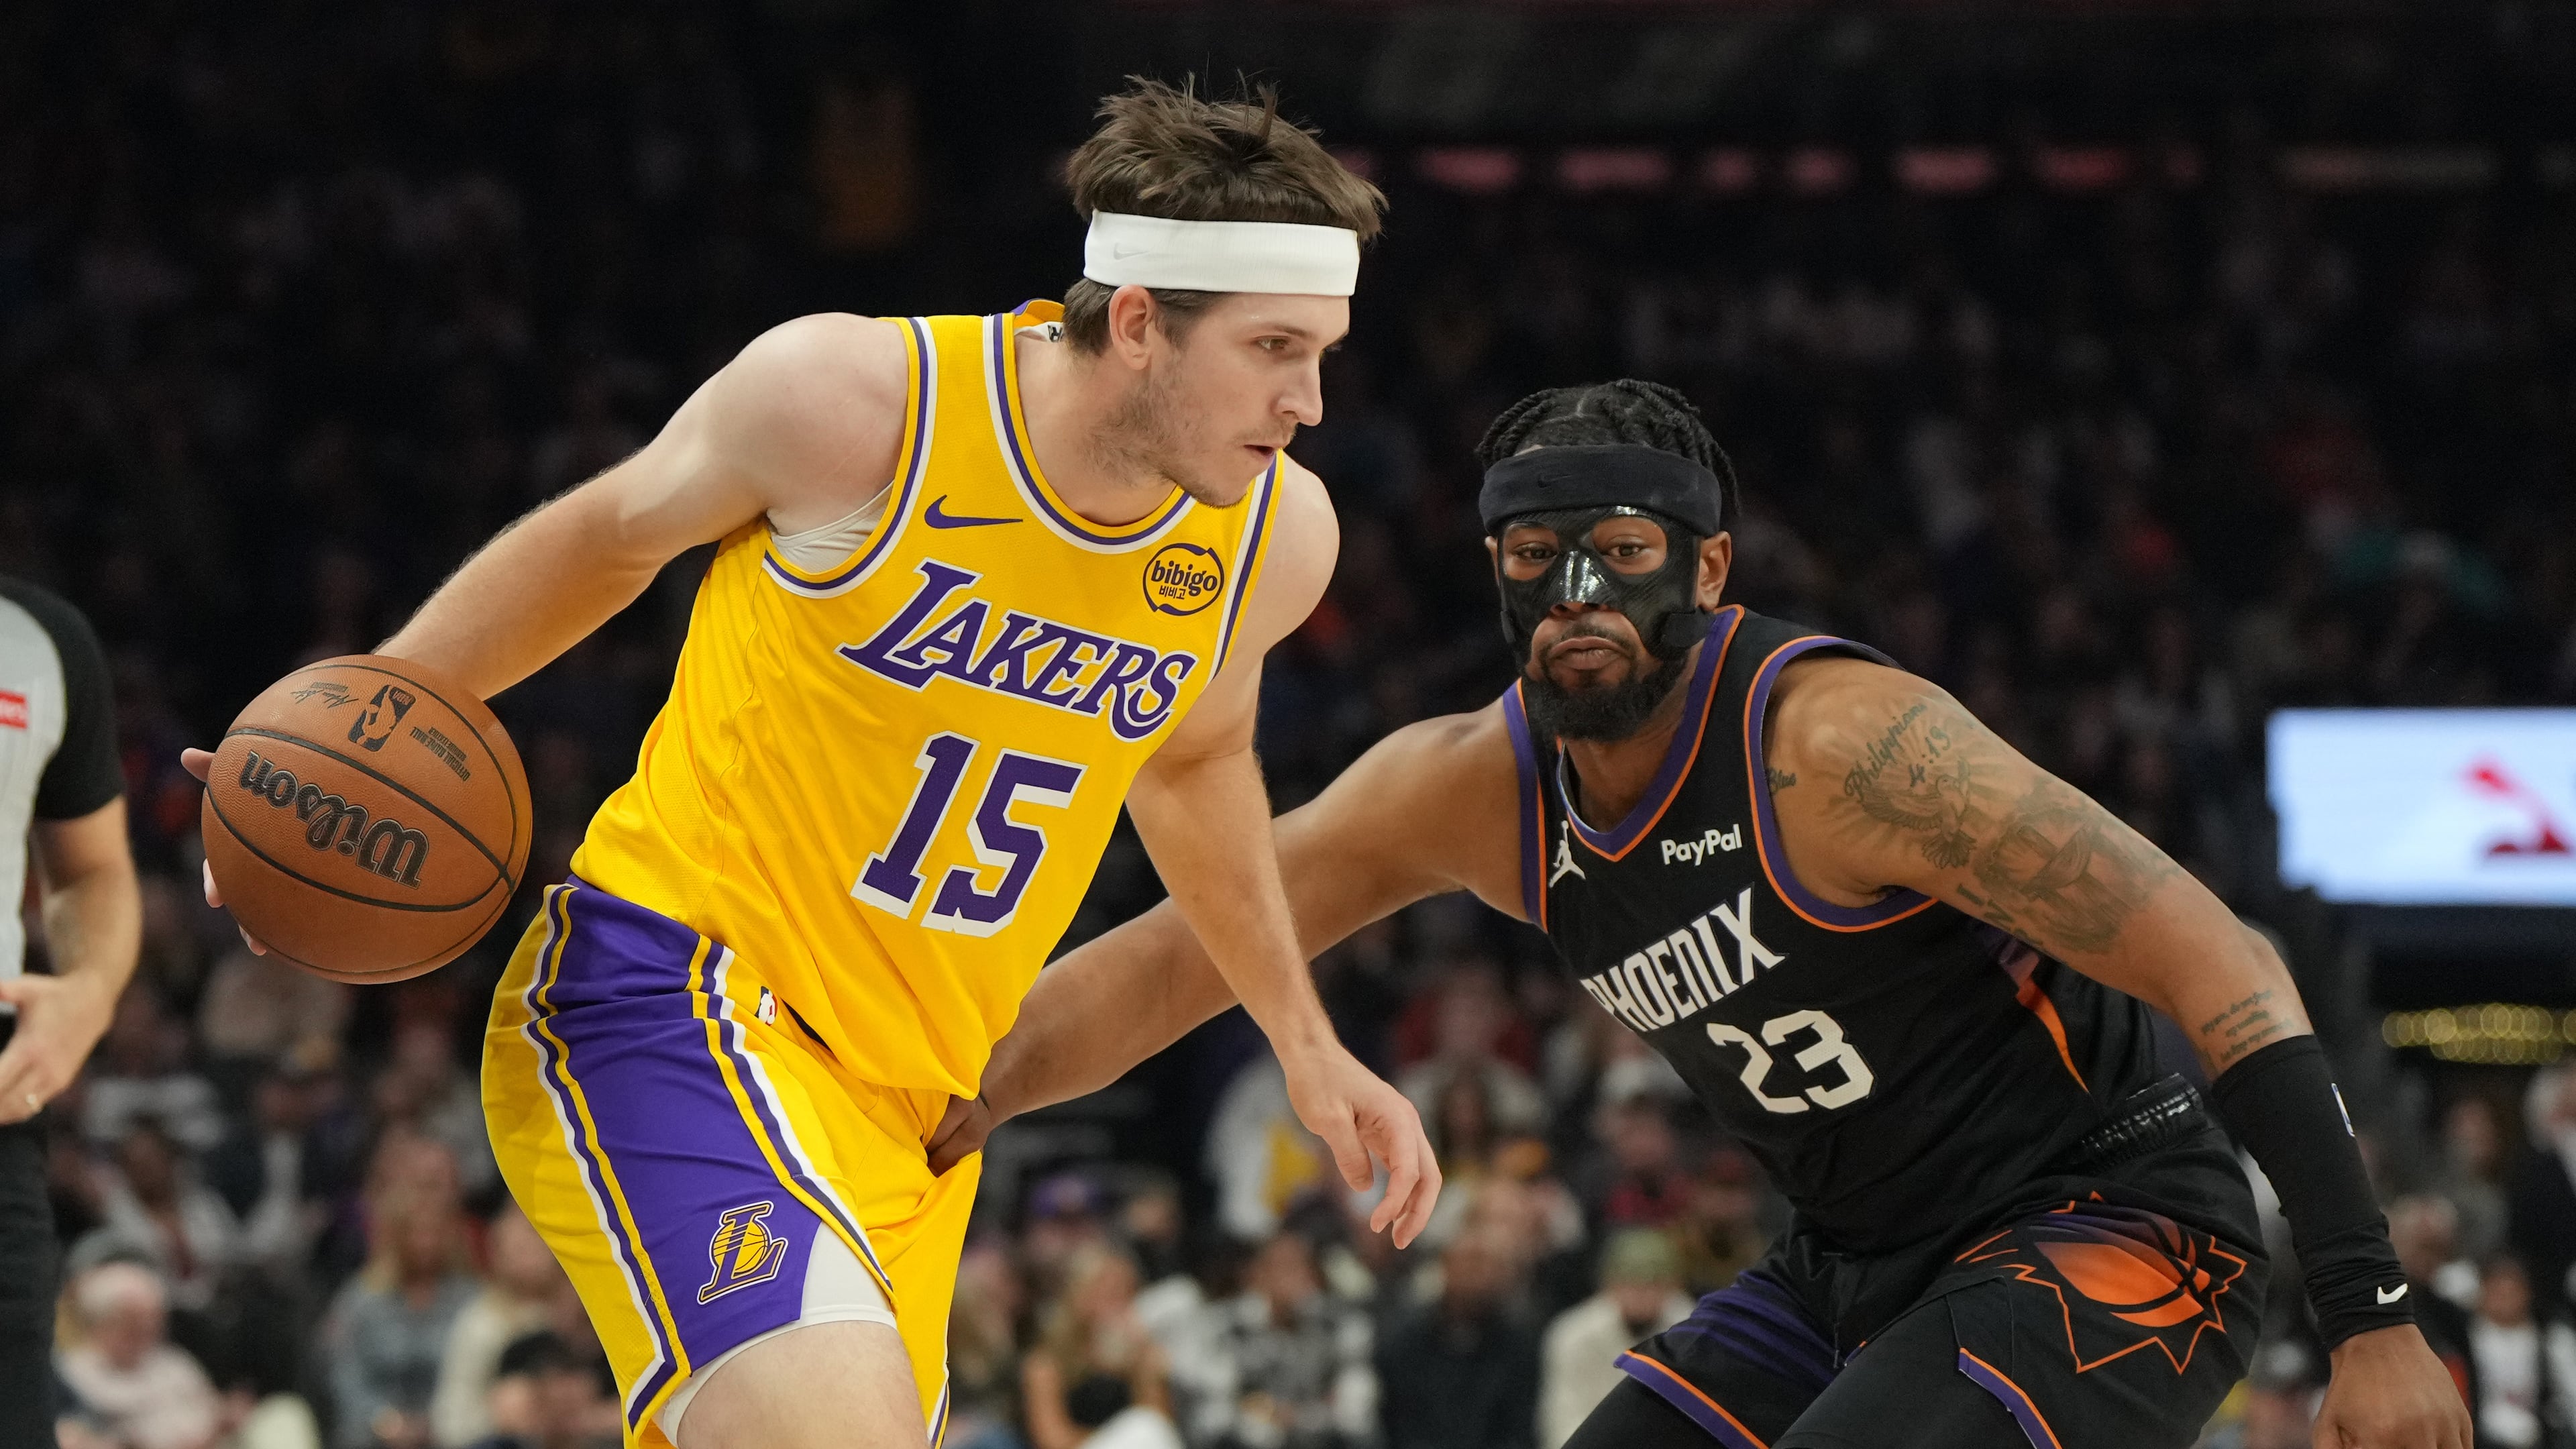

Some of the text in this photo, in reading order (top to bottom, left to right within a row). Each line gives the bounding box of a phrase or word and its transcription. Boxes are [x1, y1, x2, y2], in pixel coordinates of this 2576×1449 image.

[1150, 560, 1218, 596] bibigo
[1159, 585, 1186, 600] 비비고
[392, 690, 413, 706] NBA
[835, 556, 1199, 743] LAKERS
[239, 751, 429, 890] Wilson
[850, 730, 1088, 938] 15
[1661, 823, 1743, 867] PayPal
[1579, 883, 1788, 1032] PHOENIX
[1706, 1009, 1876, 1114] 23
